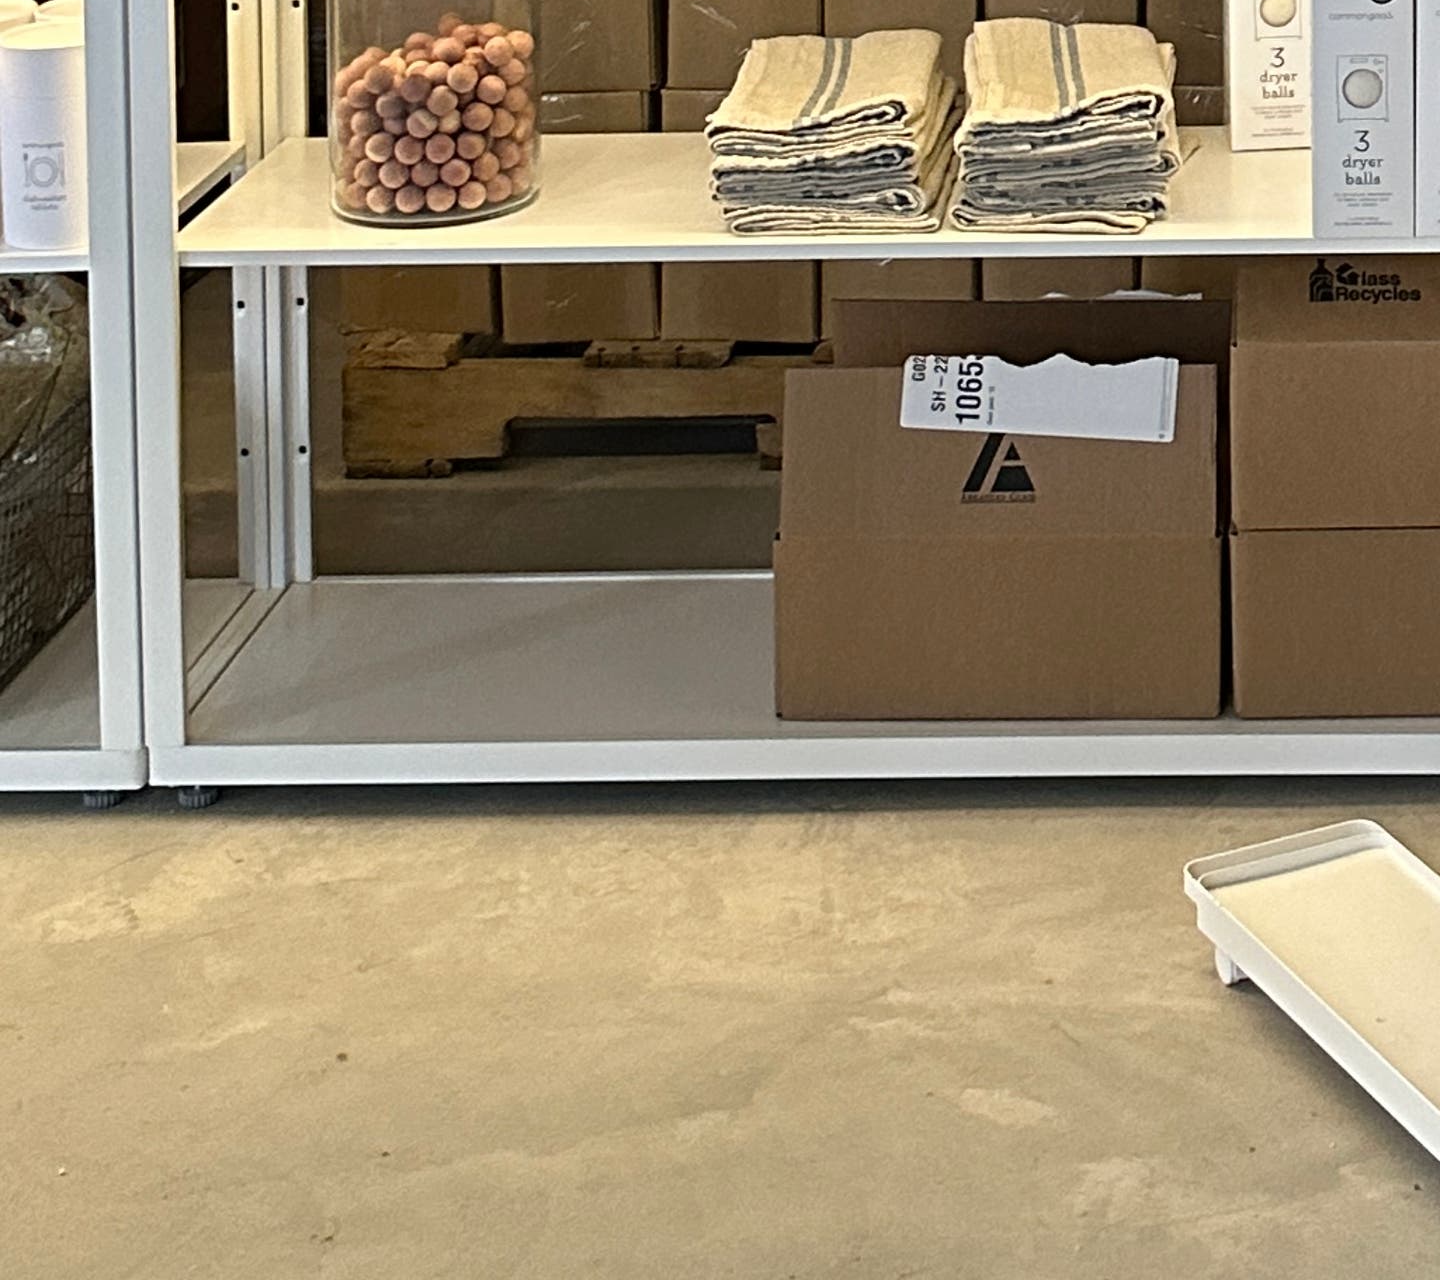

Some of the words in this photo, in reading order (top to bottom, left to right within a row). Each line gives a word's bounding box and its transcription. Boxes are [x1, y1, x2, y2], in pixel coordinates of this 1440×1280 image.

[1269, 46, 1286, 68] 3
[1259, 70, 1299, 89] dryer
[1262, 88, 1296, 100] balls
[1353, 129, 1371, 153] 3
[1342, 154, 1384, 173] dryer
[1345, 172, 1381, 186] balls
[1335, 287, 1422, 304] Recycles
[955, 354, 984, 425] 1065
